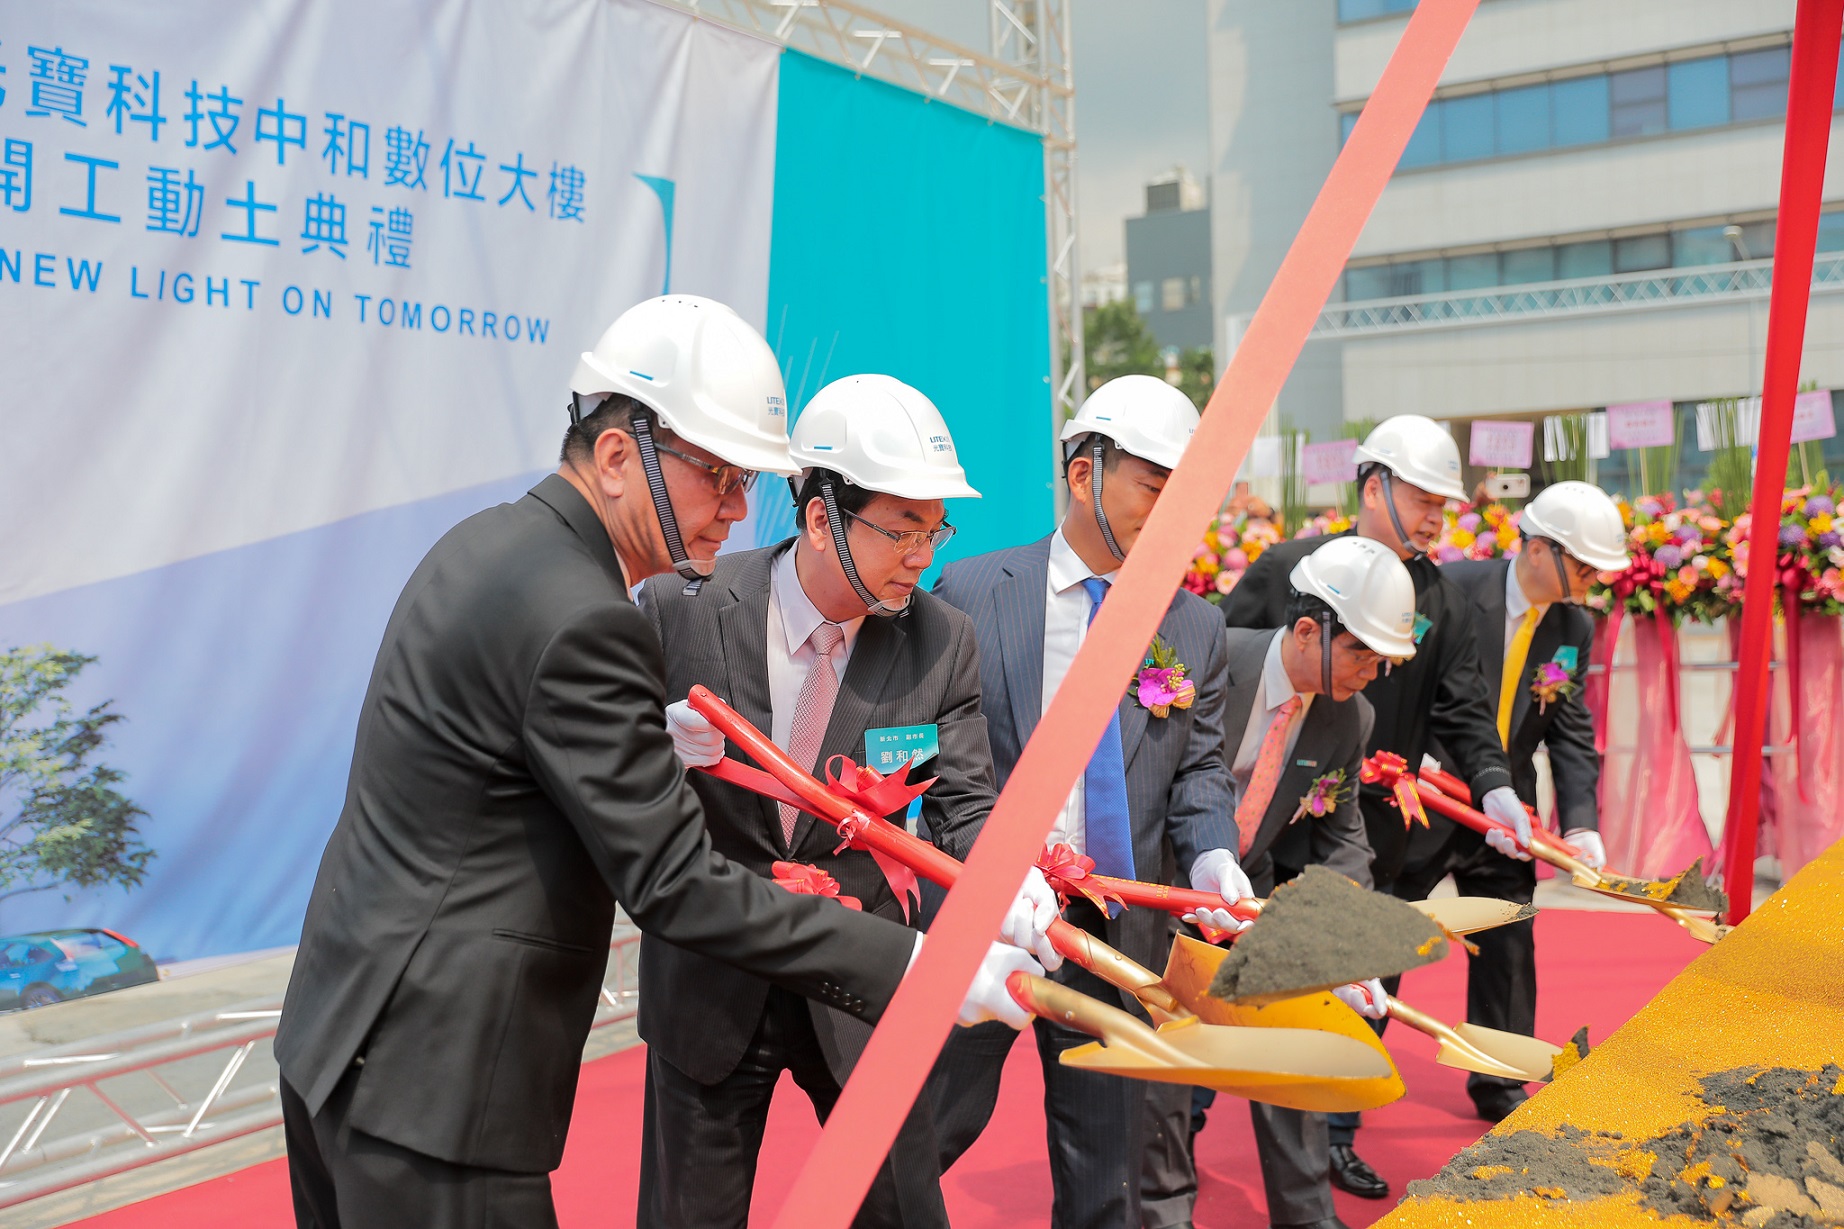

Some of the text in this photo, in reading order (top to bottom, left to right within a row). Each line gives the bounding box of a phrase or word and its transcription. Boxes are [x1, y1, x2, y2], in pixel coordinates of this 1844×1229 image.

[0, 41, 586, 223] 寶科技中和數位大樓
[0, 248, 550, 345] NEW LIGHT ON TOMORROW
[881, 748, 924, 763] 劉和然
